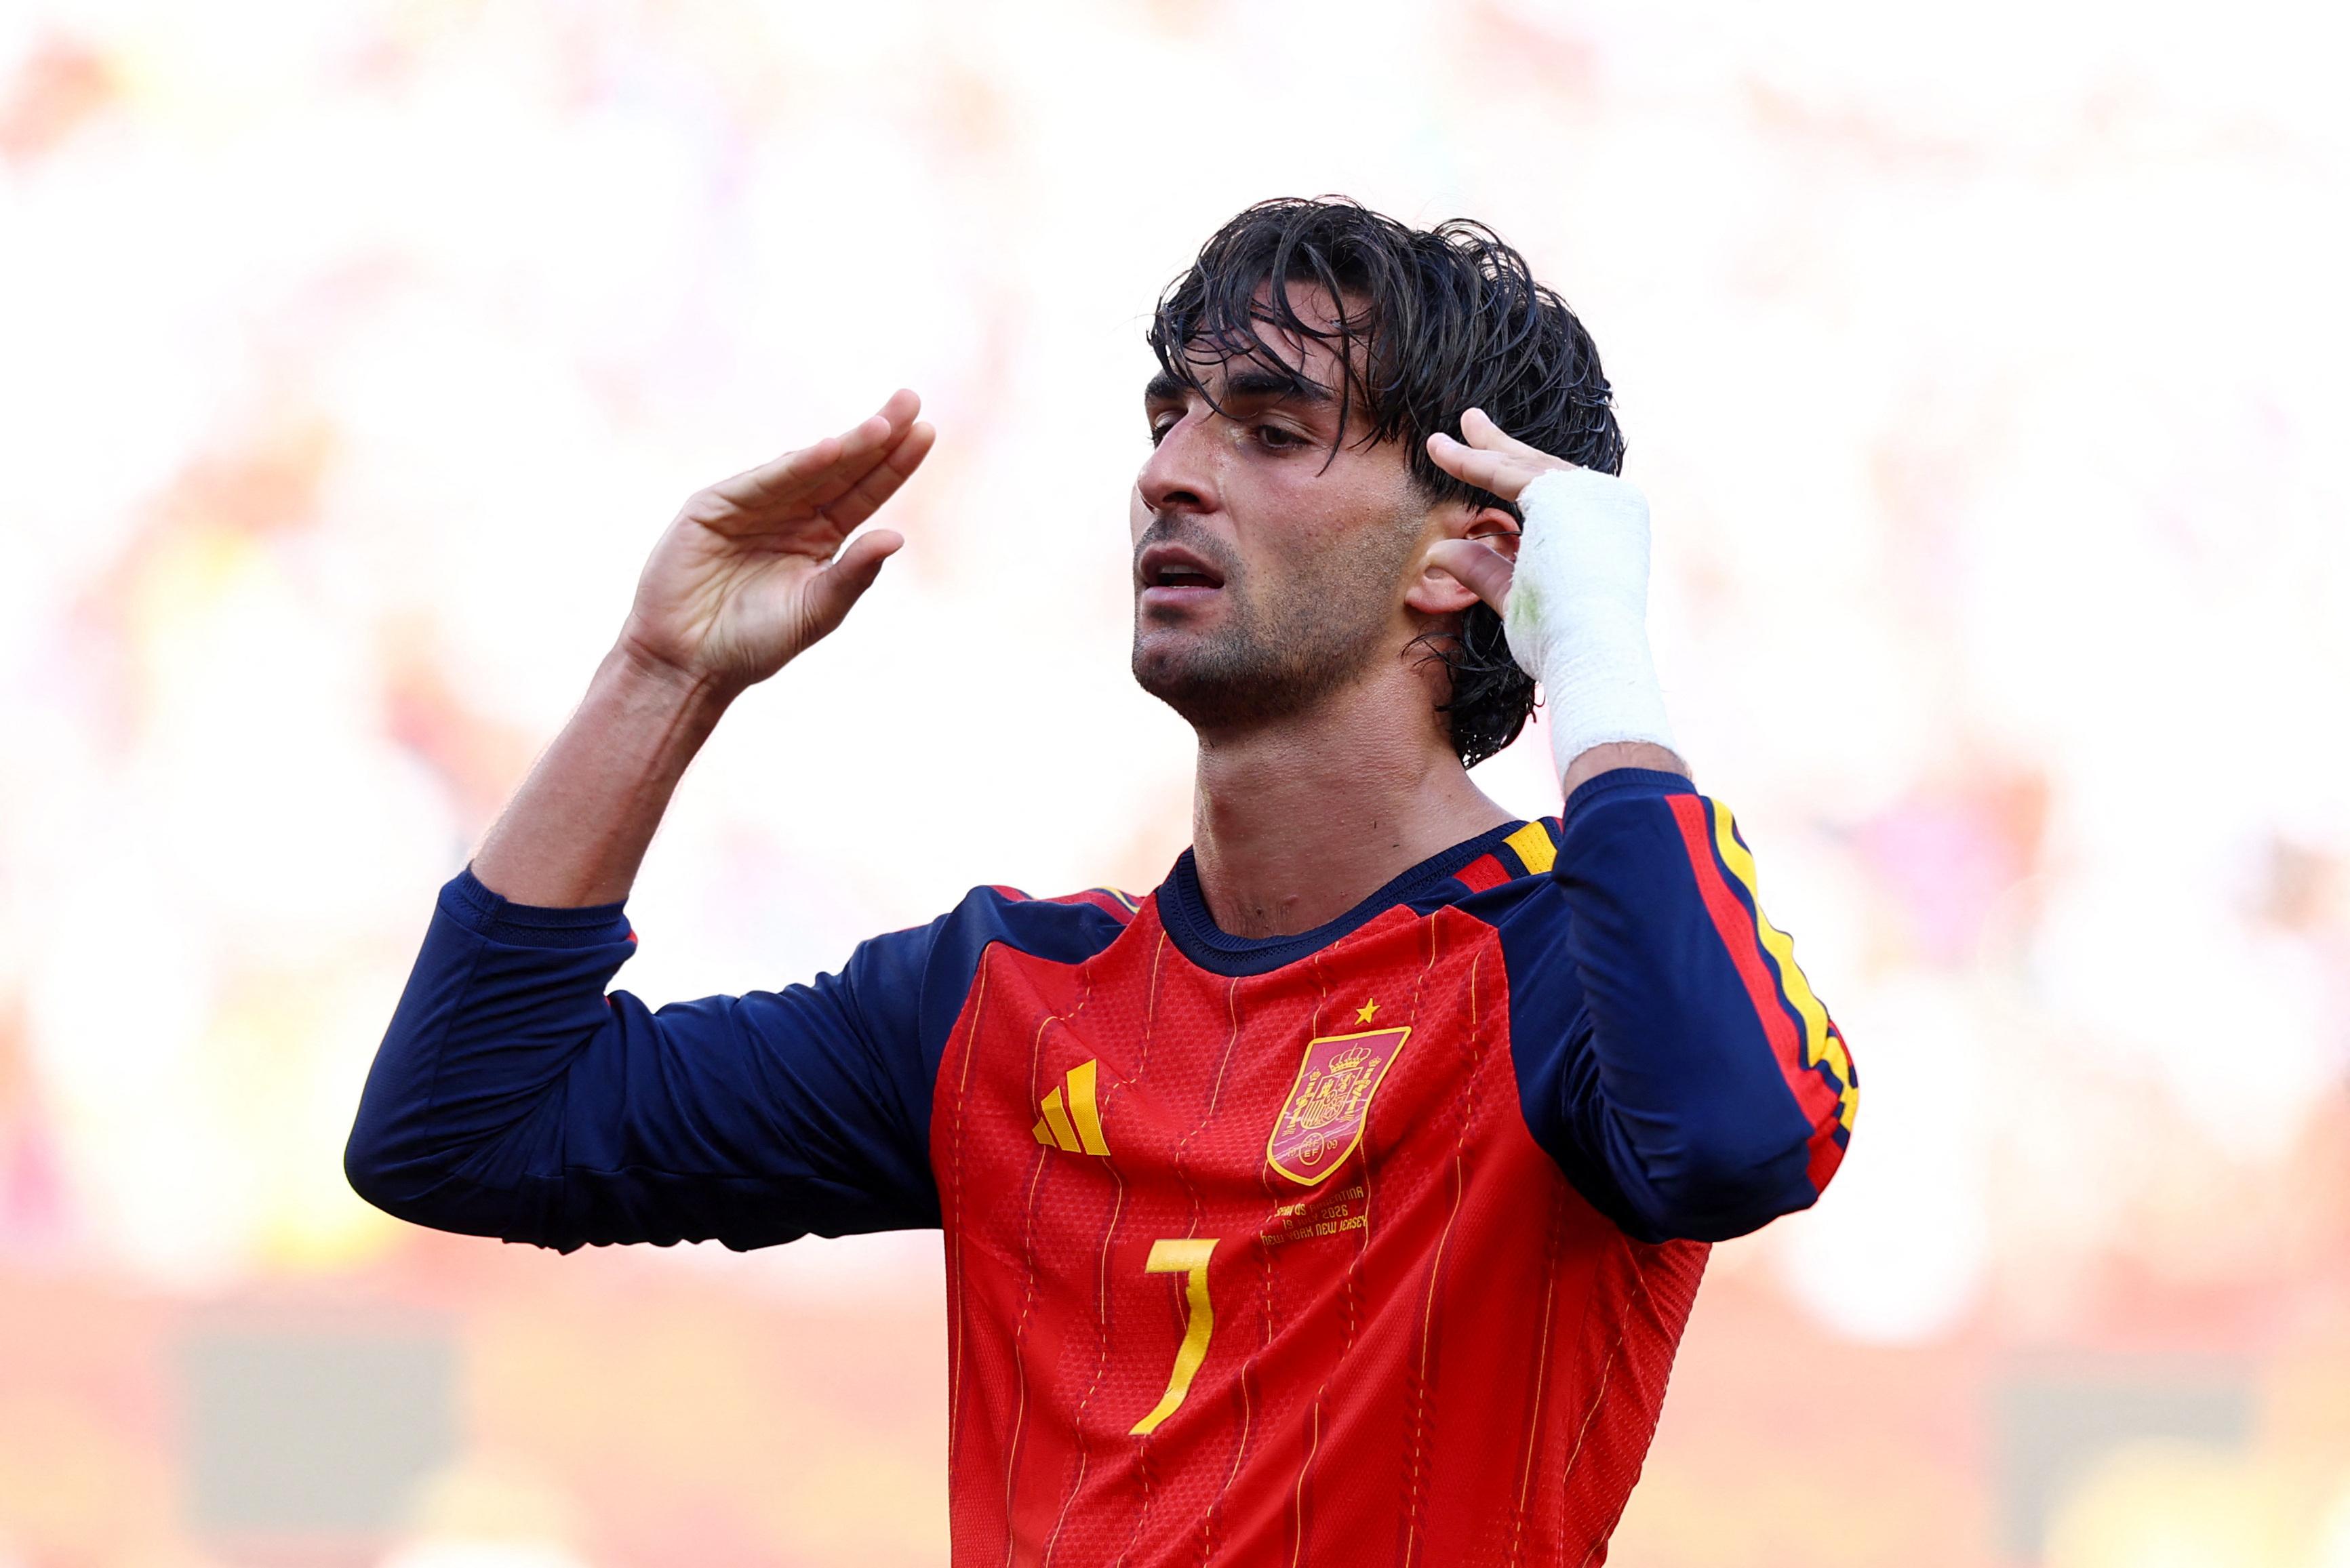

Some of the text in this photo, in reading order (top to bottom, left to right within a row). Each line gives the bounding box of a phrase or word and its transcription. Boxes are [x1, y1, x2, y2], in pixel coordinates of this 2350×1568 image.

[1322, 1205, 1349, 1219] 2026
[1260, 1215, 1368, 1246] NEW YORK NEW JERSEY
[1128, 1239, 1220, 1435] 7
